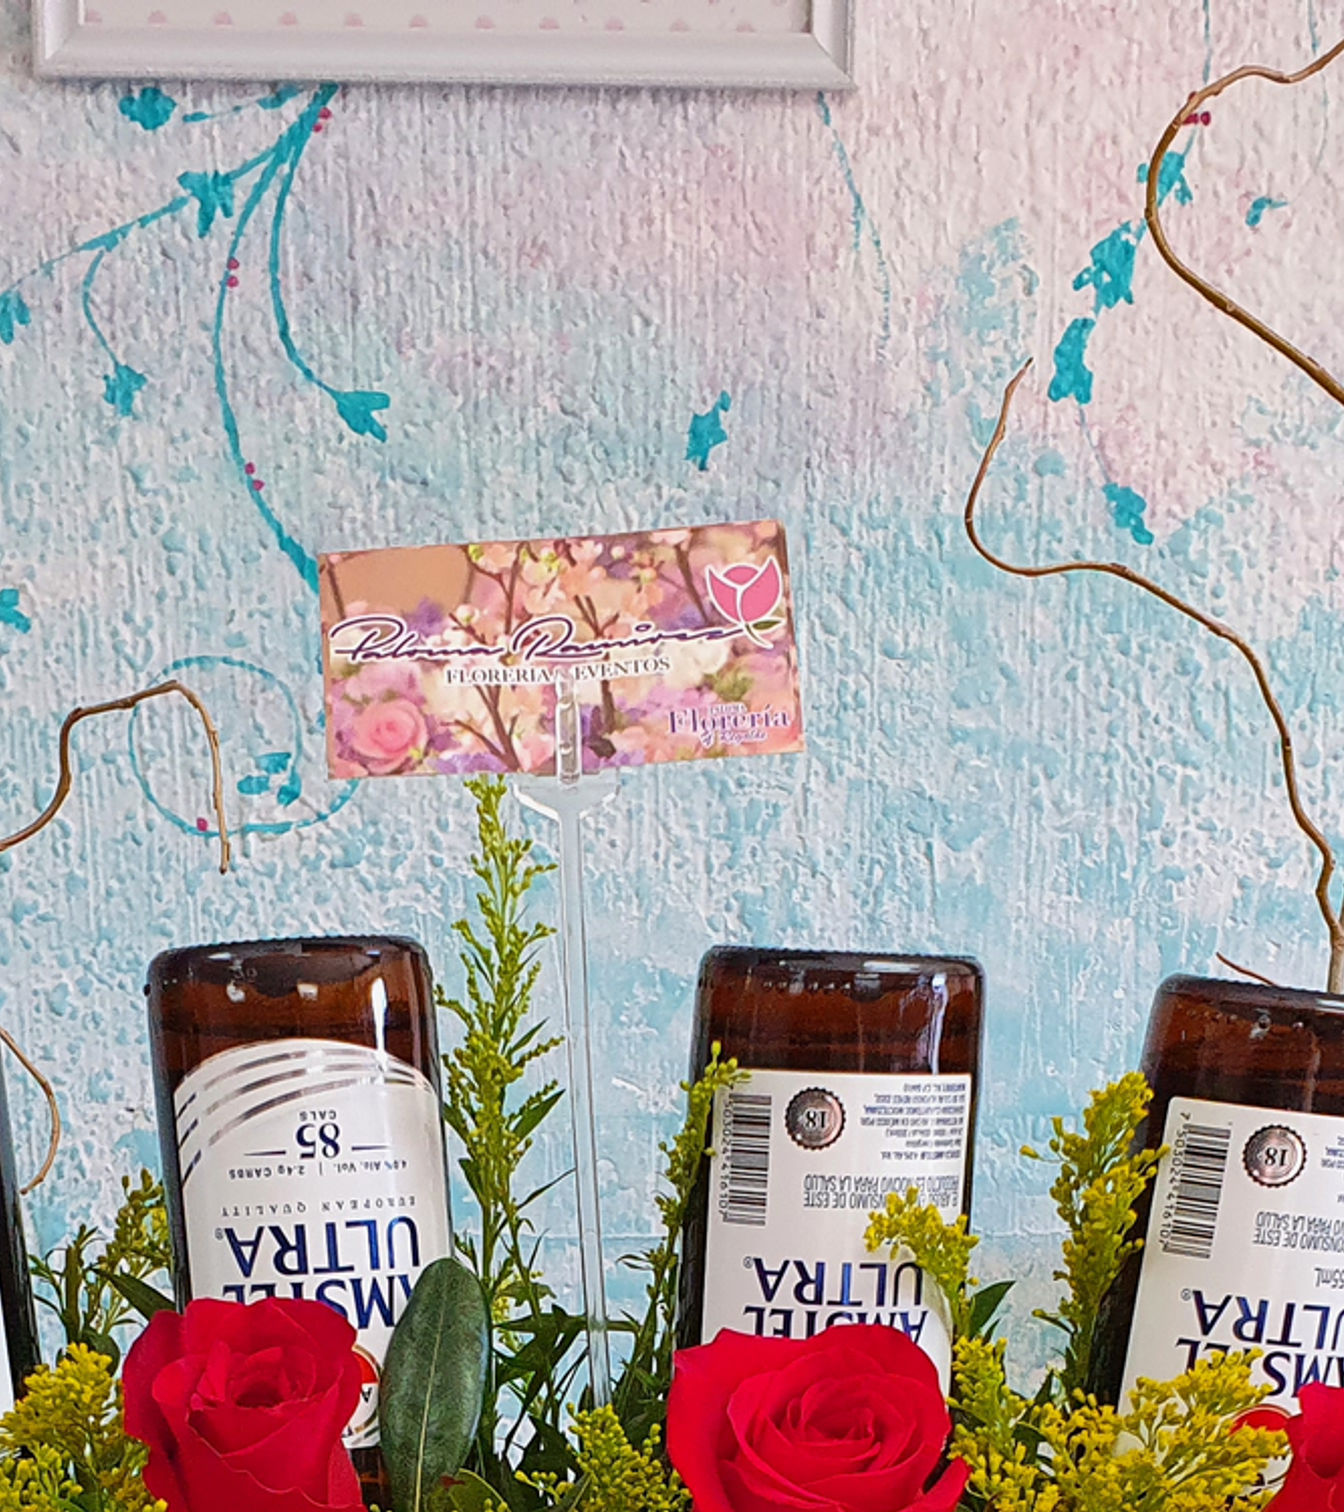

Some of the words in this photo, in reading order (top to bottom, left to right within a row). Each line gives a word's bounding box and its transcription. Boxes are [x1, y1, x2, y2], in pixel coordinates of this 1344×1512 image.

[331, 617, 502, 662] Paloma
[576, 657, 671, 681] EVENTOS
[298, 1109, 336, 1122] CALS
[296, 1122, 340, 1159] 85
[333, 1162, 356, 1173] Vol.
[804, 1175, 836, 1190] SALUD
[838, 1176, 851, 1190] LA
[853, 1176, 878, 1192] PARA
[321, 1195, 415, 1212] EUROPEAN
[803, 1191, 829, 1207] ESTE
[831, 1192, 845, 1208] DE
[221, 1201, 306, 1218] QUALITY
[1255, 1210, 1290, 1228] SALUD
[1292, 1215, 1304, 1230] LA
[1306, 1217, 1332, 1234] PARA
[1252, 1227, 1281, 1245] ESTE
[1282, 1230, 1297, 1248] DE
